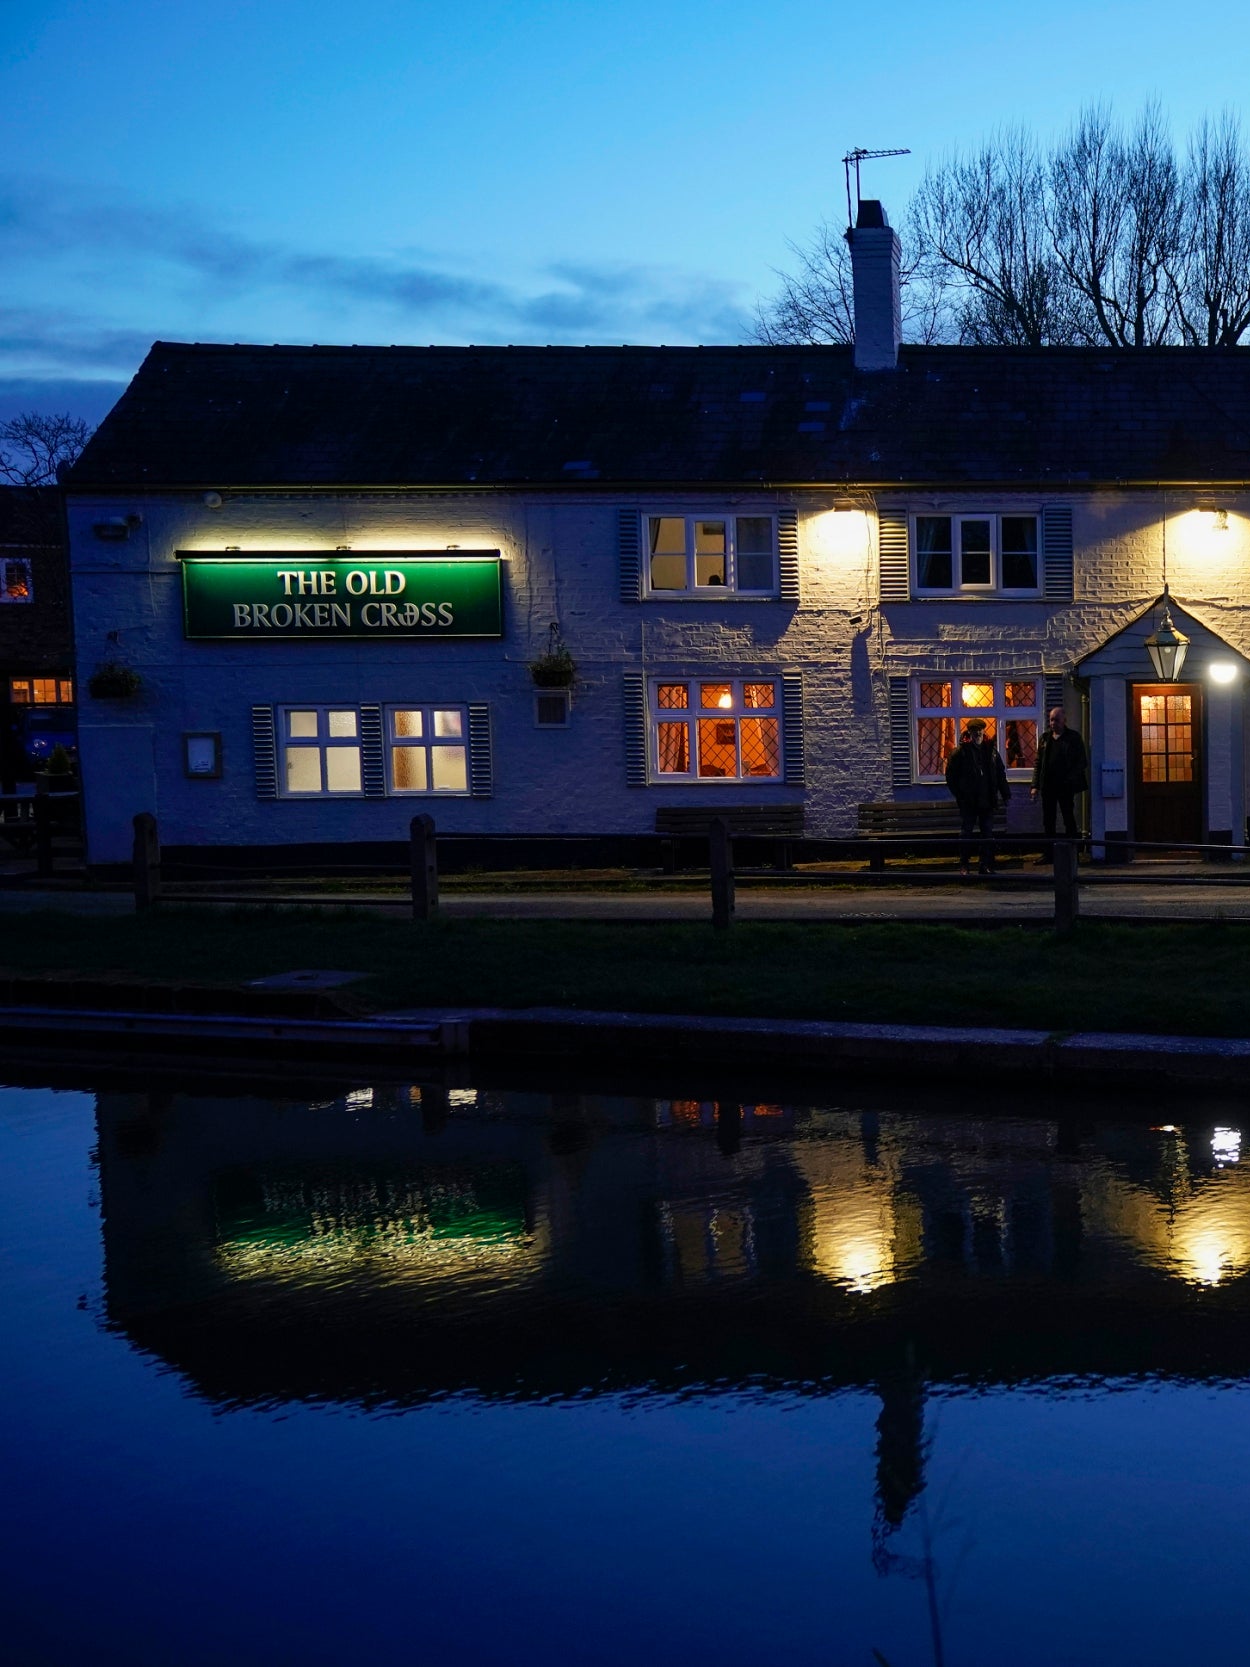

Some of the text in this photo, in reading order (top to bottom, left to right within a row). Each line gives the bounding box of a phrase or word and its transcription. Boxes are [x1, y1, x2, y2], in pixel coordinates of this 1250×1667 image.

[277, 570, 406, 595] THE OLD
[232, 602, 454, 628] BROKEN CROSS
